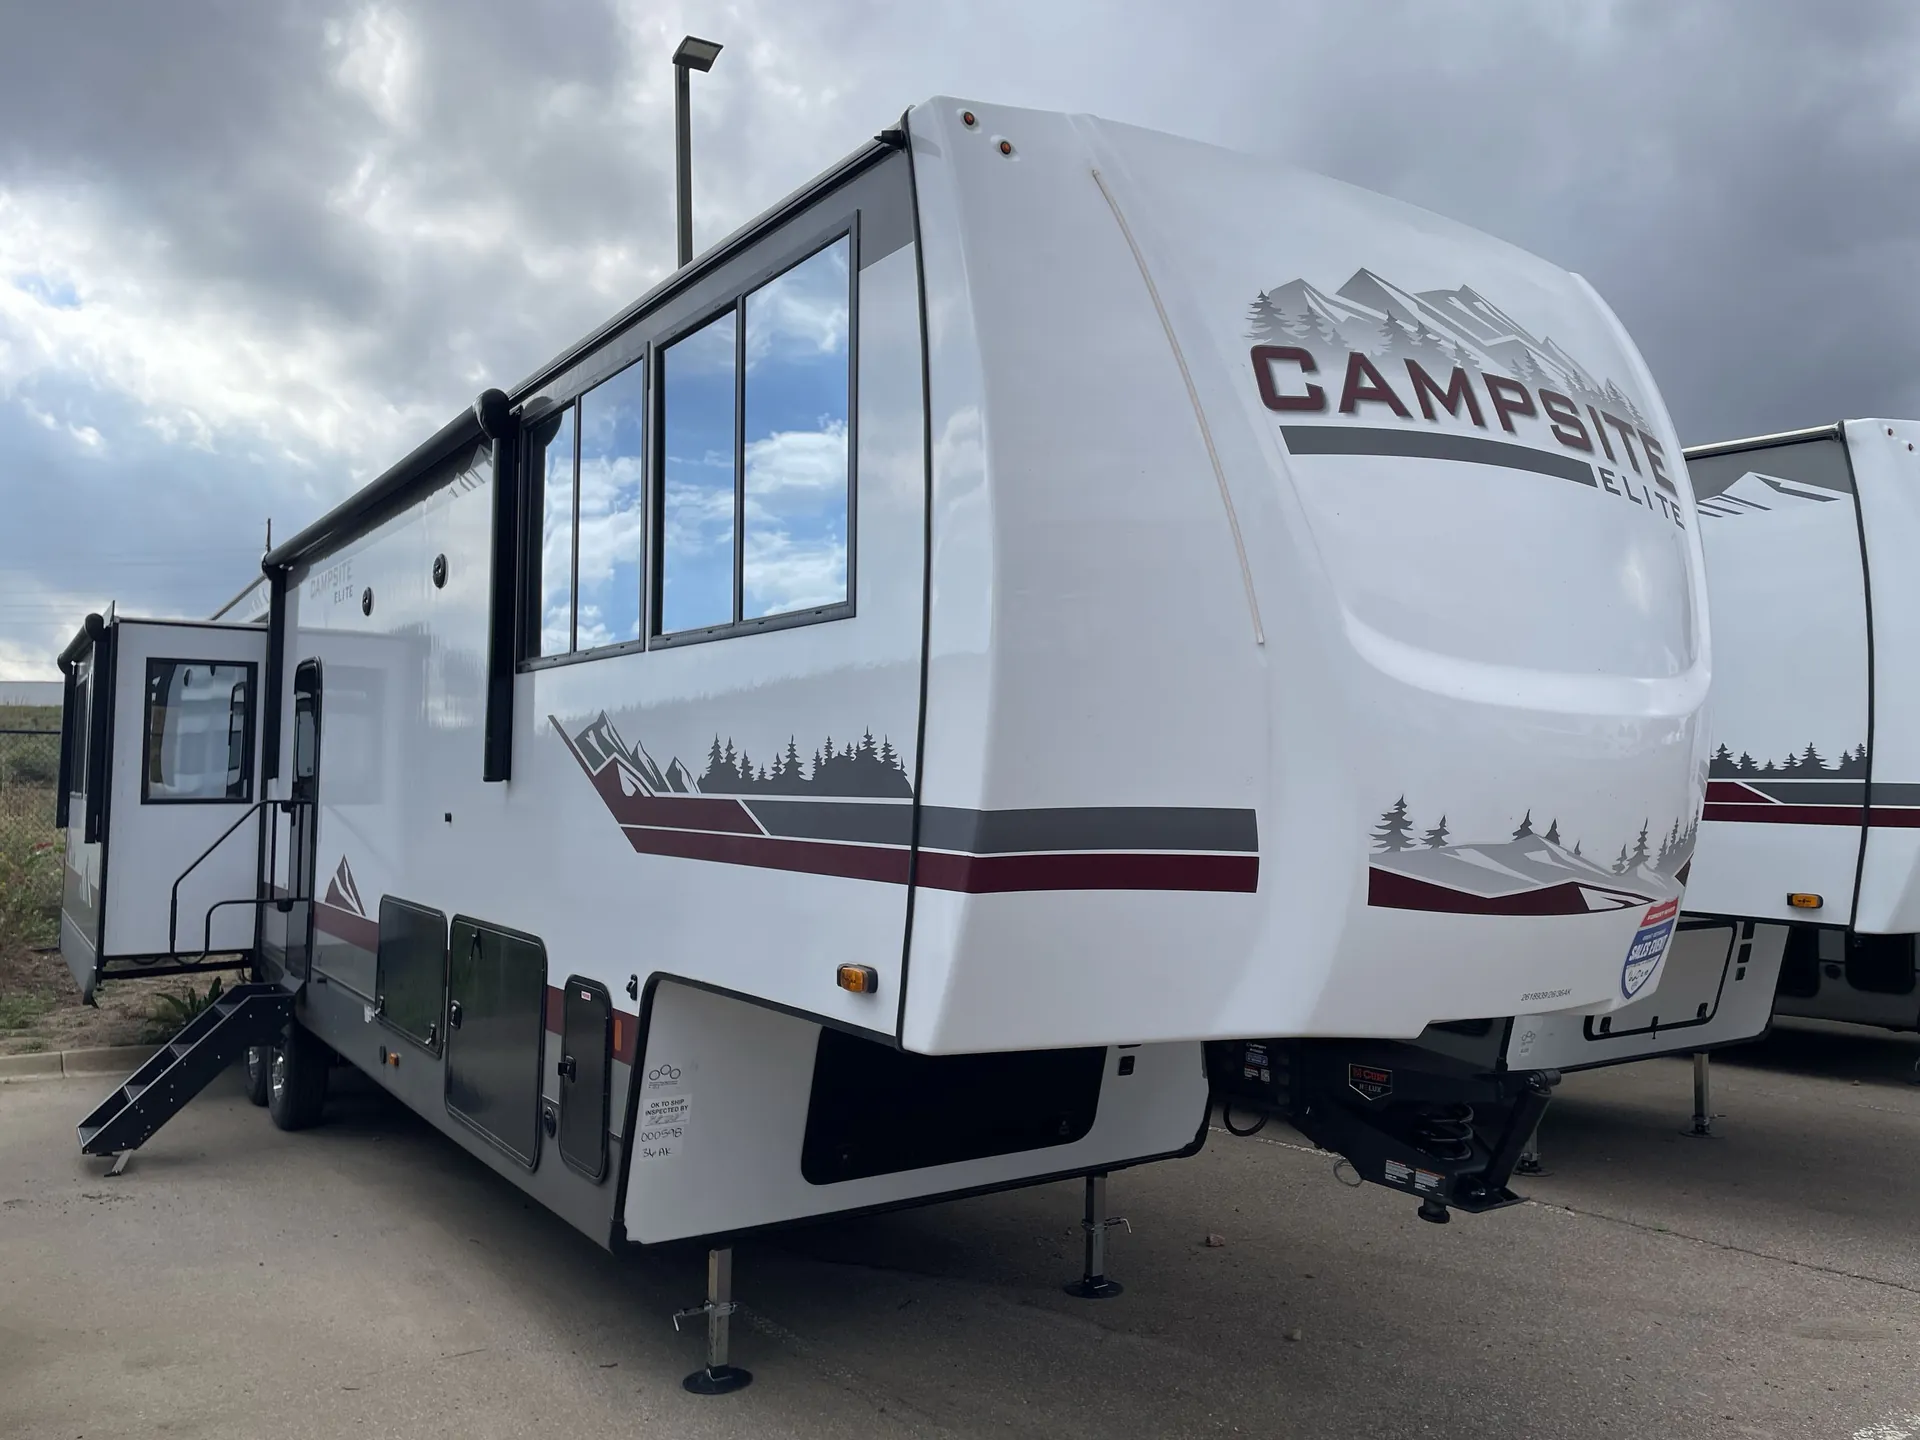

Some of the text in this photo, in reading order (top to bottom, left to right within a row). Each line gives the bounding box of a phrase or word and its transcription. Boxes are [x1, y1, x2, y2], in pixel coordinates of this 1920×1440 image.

[1249, 343, 1679, 498] CAMPSITE
[1597, 465, 1686, 531] ELITE
[334, 584, 354, 604] ELITE
[1628, 941, 1652, 962] SALES
[1648, 934, 1668, 956] EVENT
[645, 1106, 680, 1116] INSPECTED
[670, 1098, 685, 1106] SHIP
